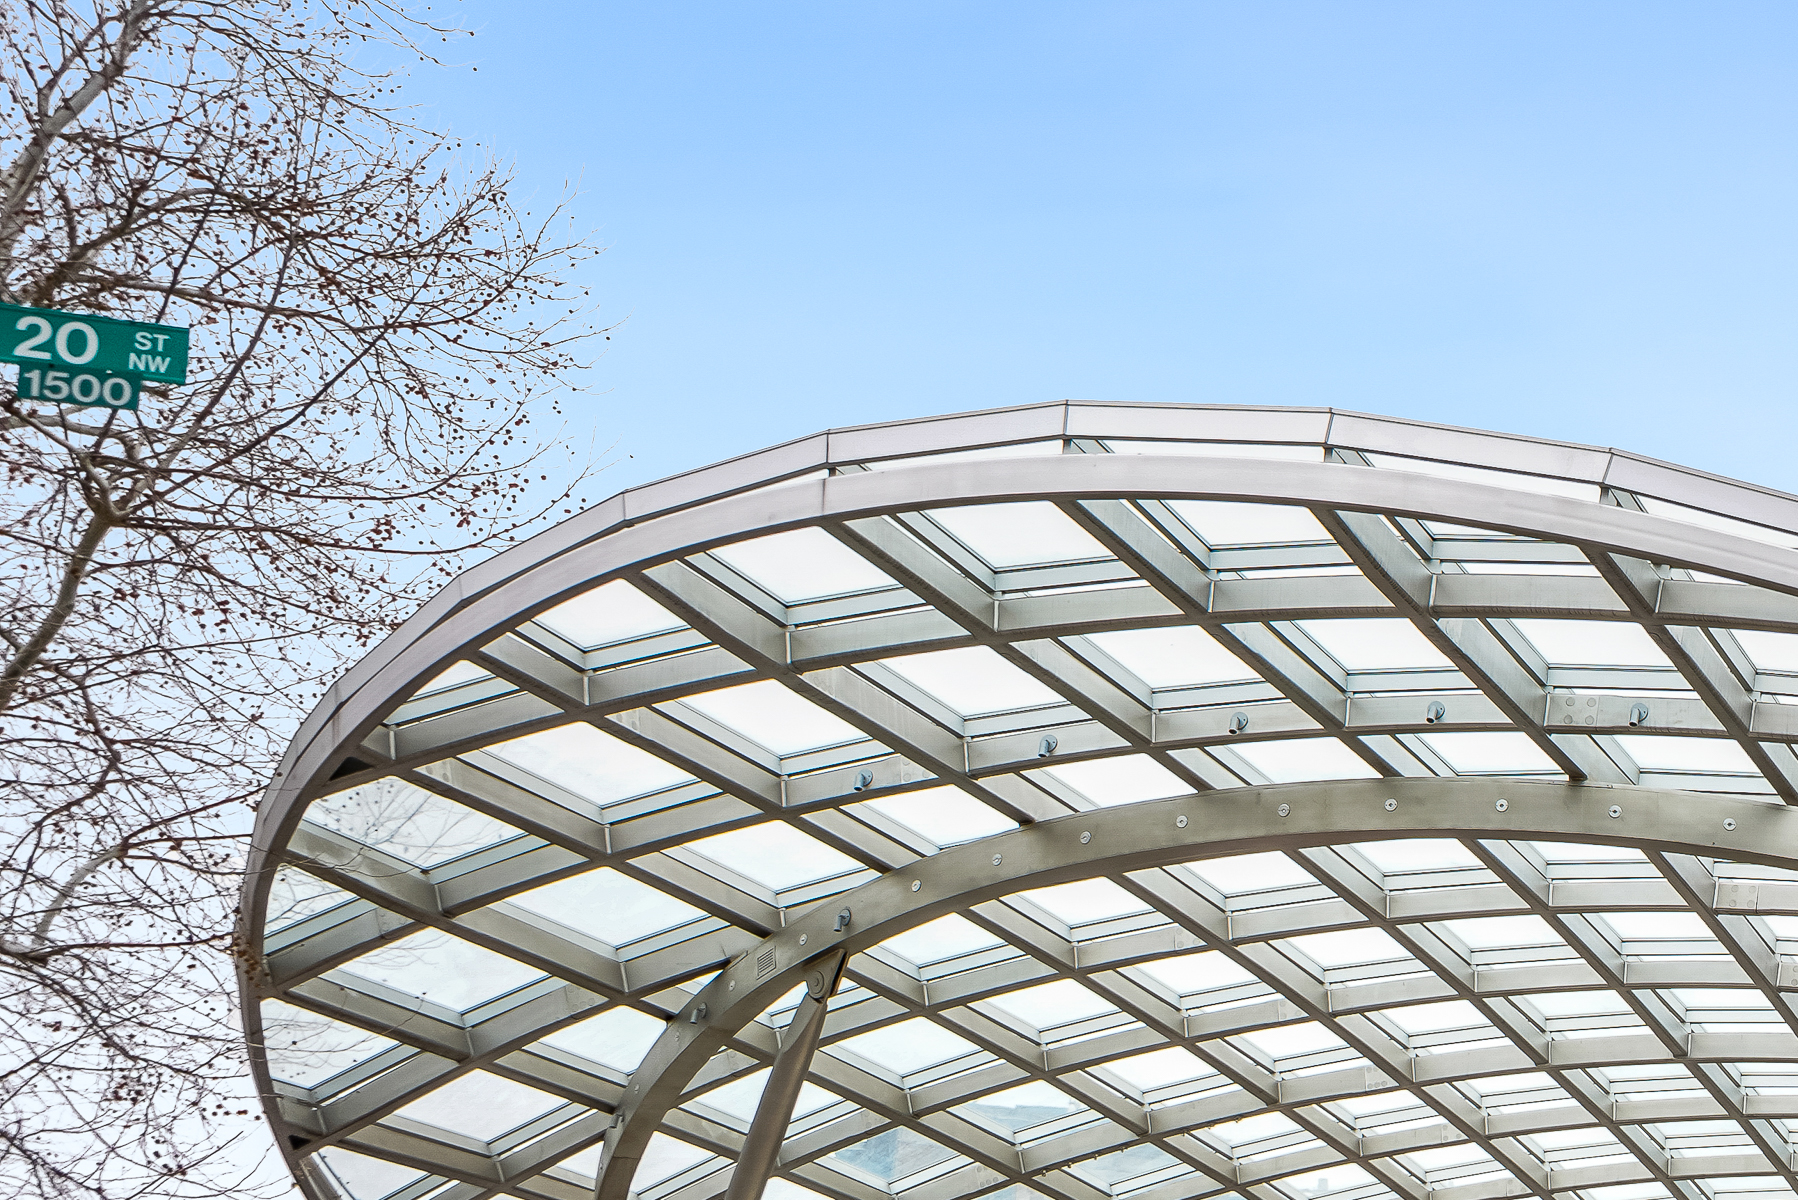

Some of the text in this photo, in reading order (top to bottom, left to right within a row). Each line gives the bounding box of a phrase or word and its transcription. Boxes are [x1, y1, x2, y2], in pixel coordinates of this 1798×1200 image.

[12, 315, 171, 365] 20 ST
[128, 352, 171, 373] NW
[23, 369, 133, 406] 1500
